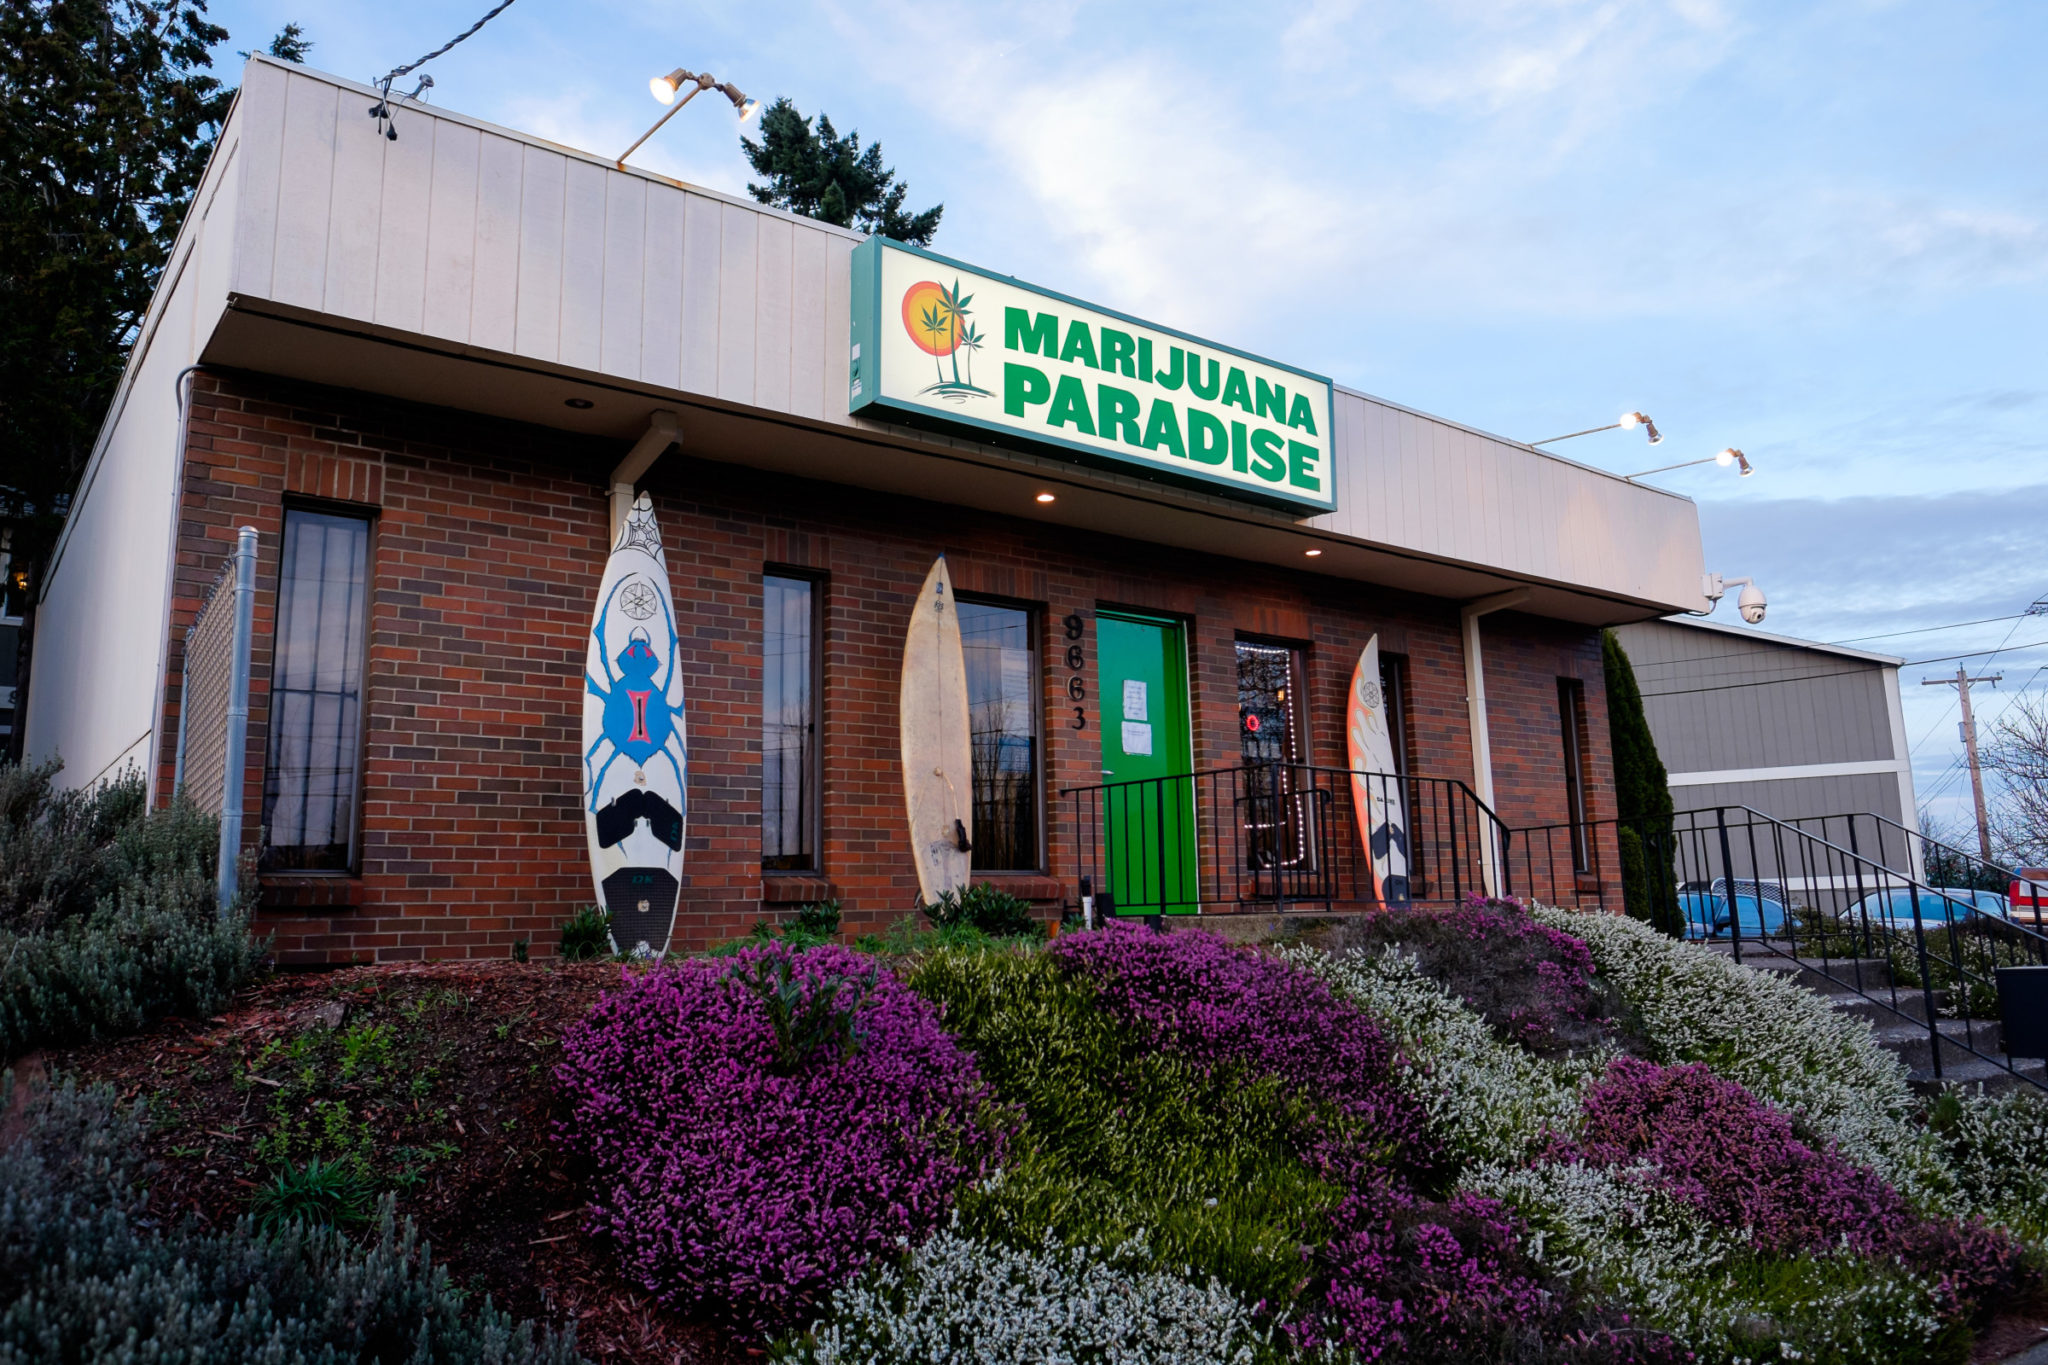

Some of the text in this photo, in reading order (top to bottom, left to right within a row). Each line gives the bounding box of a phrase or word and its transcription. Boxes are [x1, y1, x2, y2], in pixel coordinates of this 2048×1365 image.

[1004, 306, 1318, 436] MARIJUANA
[1004, 362, 1321, 492] PARADISE
[1064, 614, 1086, 730] 9663
